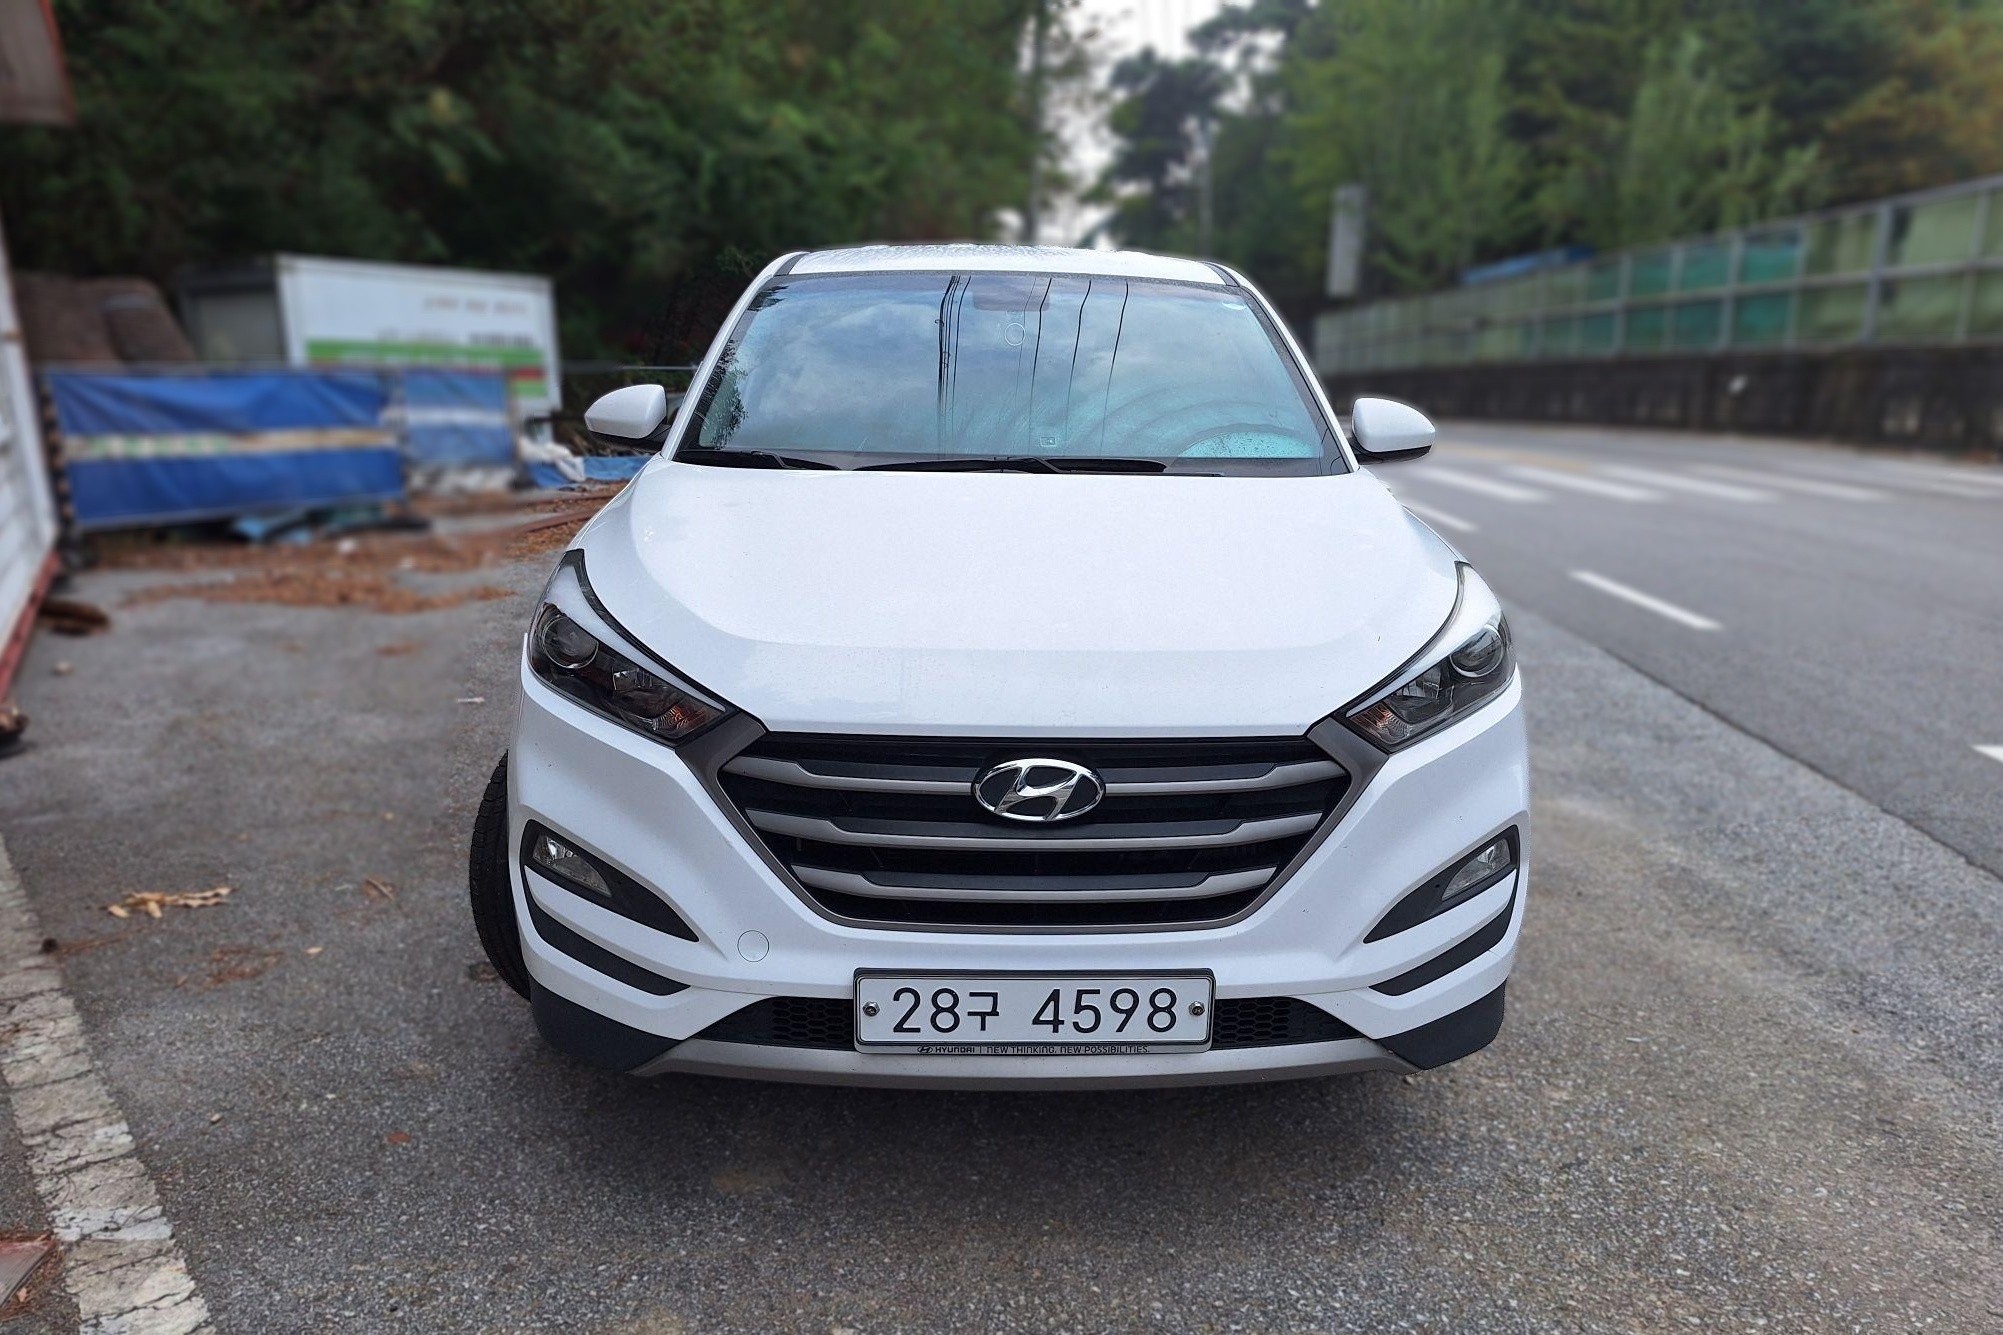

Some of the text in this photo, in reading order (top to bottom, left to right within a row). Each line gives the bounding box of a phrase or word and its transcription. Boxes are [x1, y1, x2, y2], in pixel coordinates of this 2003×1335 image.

[892, 986, 1178, 1034] 28구 4598
[935, 1045, 975, 1054] HYUNDAI
[986, 1045, 1009, 1054] NEW
[1060, 1045, 1082, 1054] NEW
